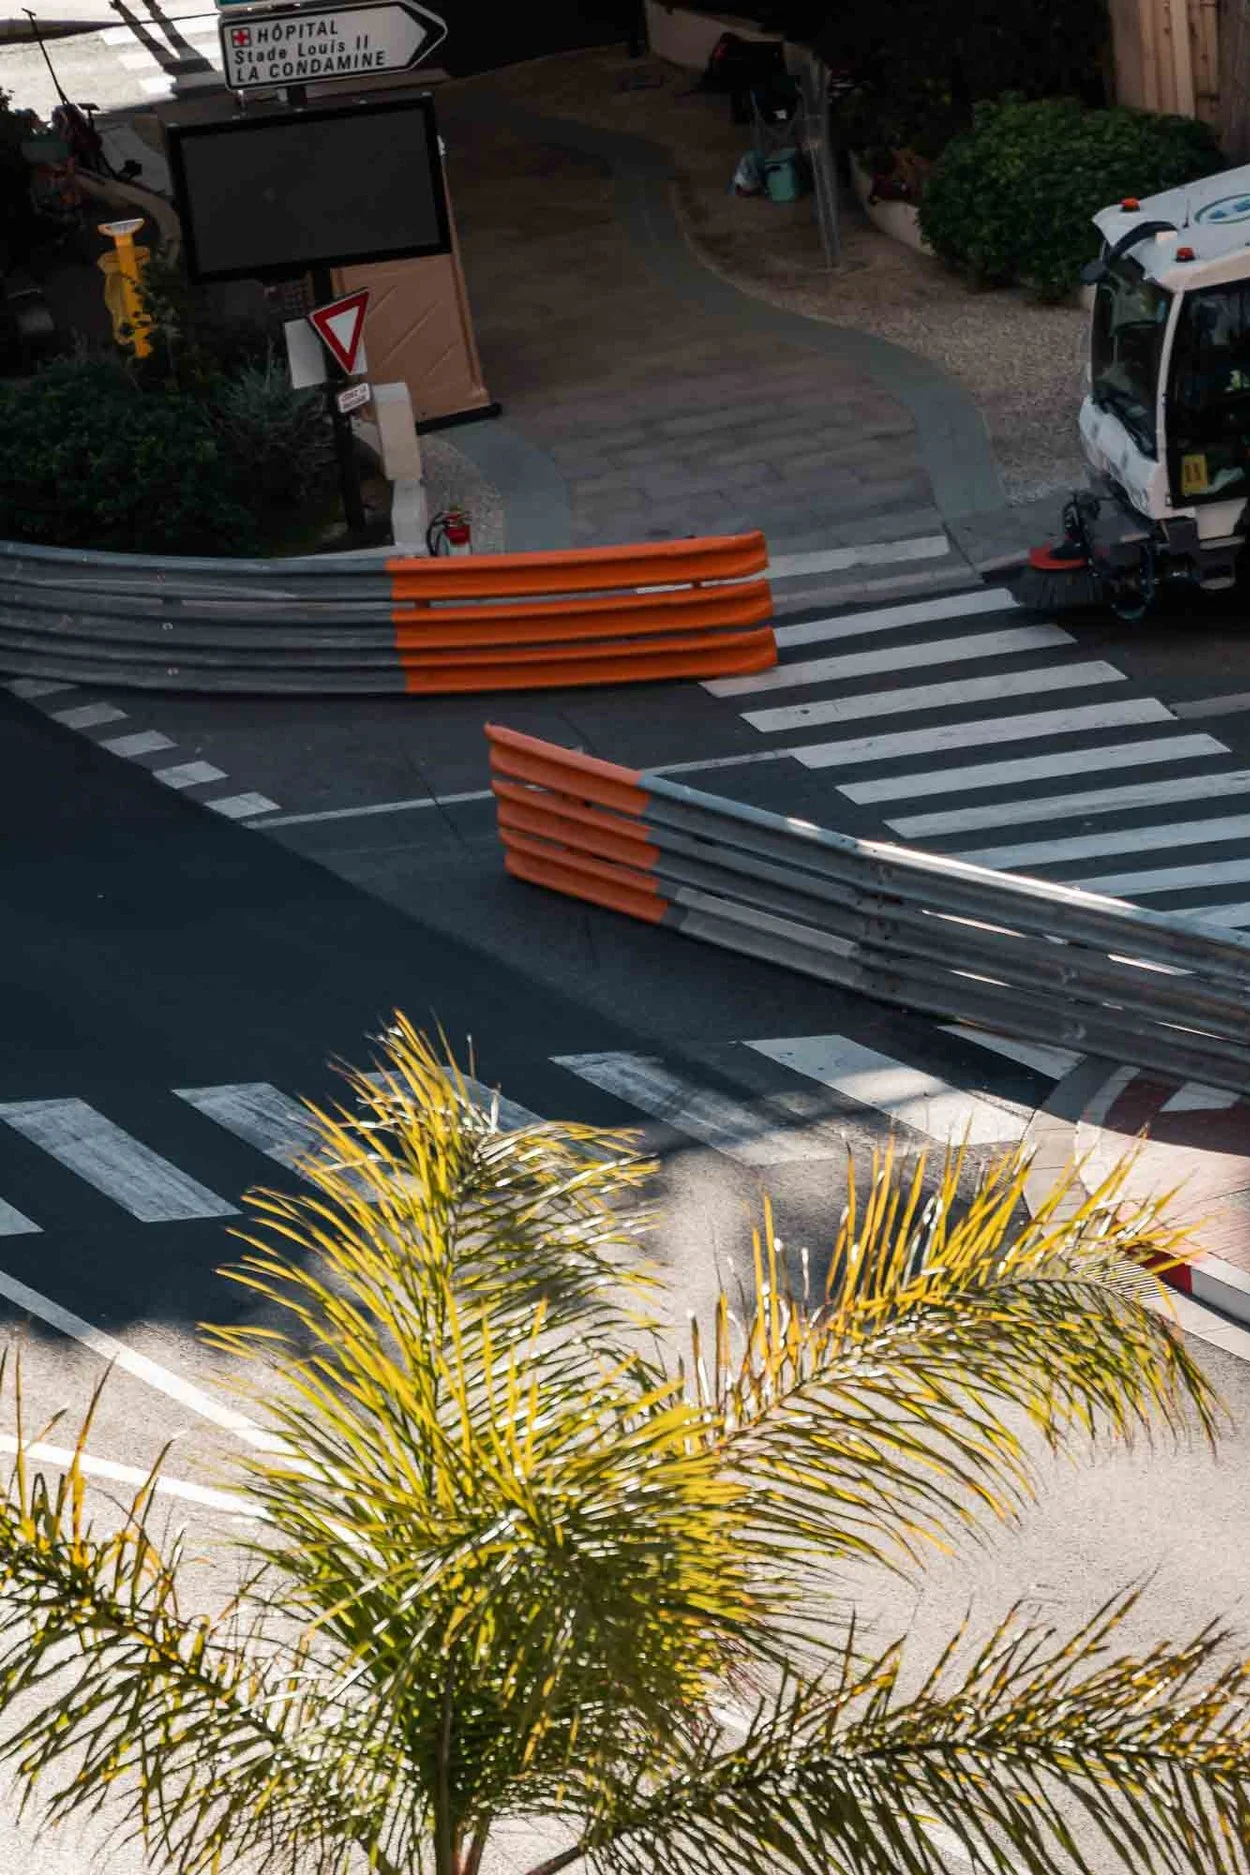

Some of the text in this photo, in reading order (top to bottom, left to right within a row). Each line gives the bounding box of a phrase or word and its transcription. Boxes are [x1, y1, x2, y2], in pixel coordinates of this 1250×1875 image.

[257, 20, 338, 44] HÔPITAL
[234, 34, 369, 65] Stade Louis II
[236, 51, 385, 83] LA CONDAMINE
